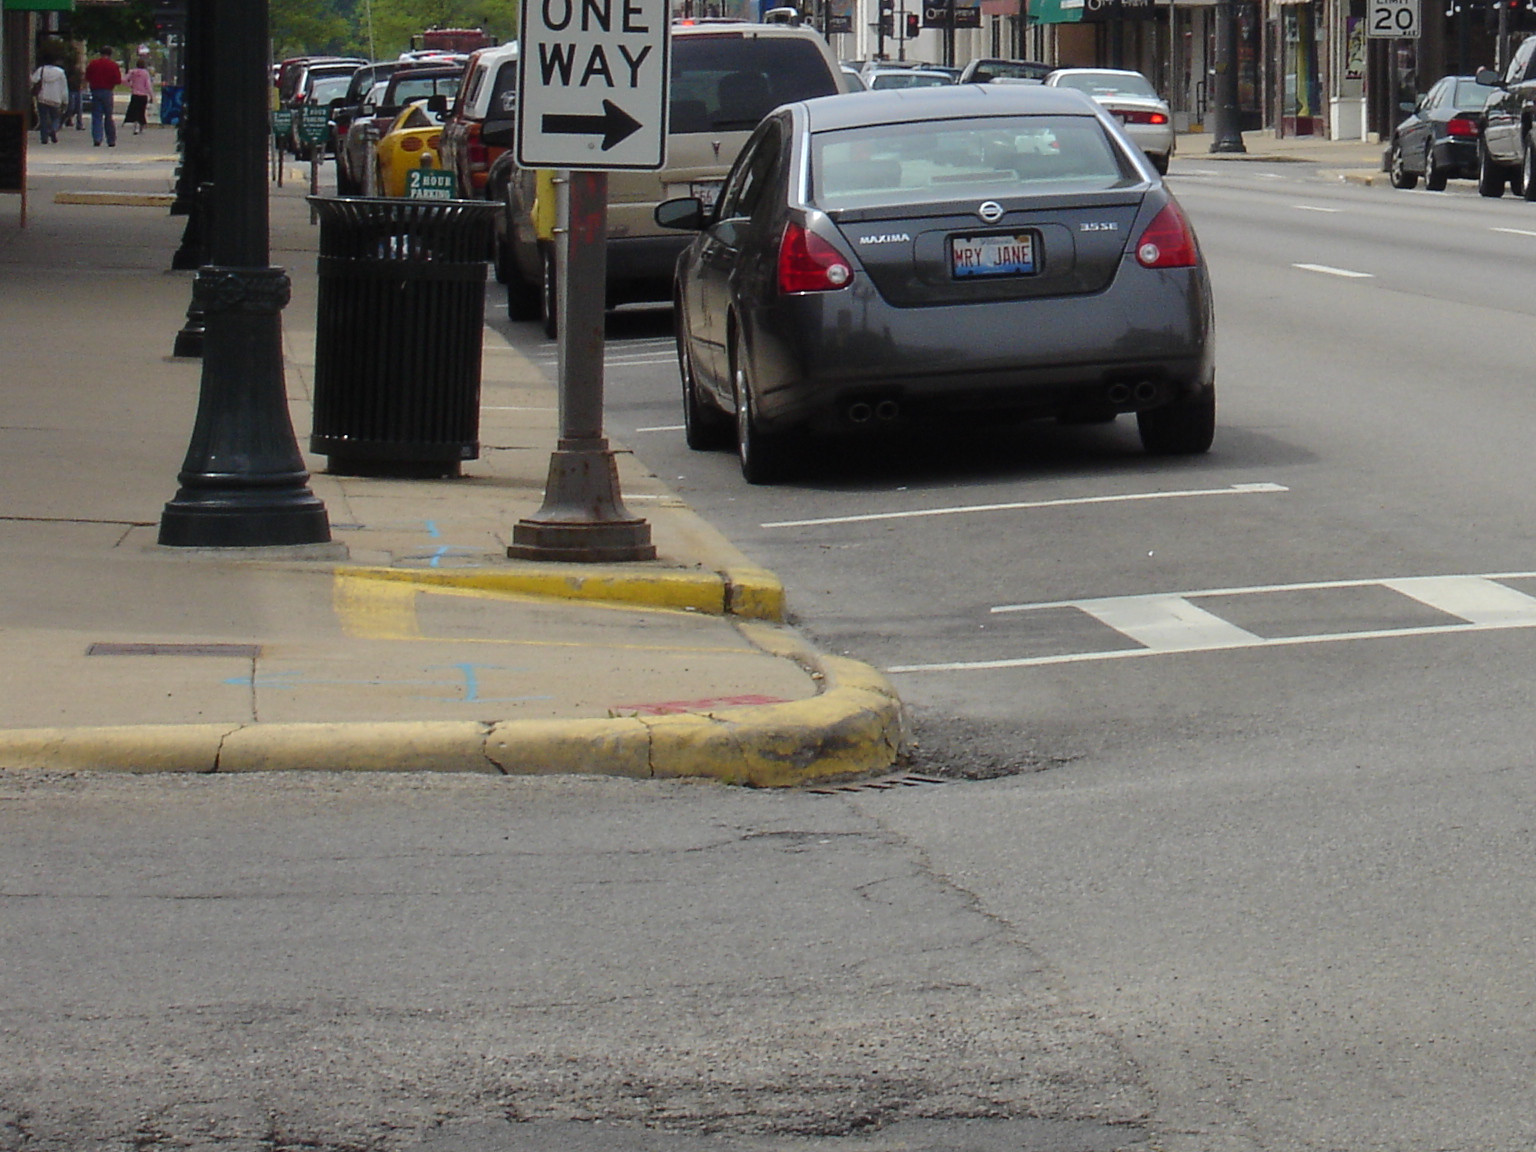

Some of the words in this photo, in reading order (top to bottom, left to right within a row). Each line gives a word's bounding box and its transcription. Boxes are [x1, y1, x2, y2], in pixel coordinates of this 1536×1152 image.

[1374, 8, 1414, 30] 20
[538, 43, 652, 88] WAY
[411, 171, 420, 188] 2
[423, 176, 451, 187] HOUR
[859, 233, 911, 245] MAXIMA
[953, 248, 982, 267] MRY
[993, 245, 1031, 266] JANE
